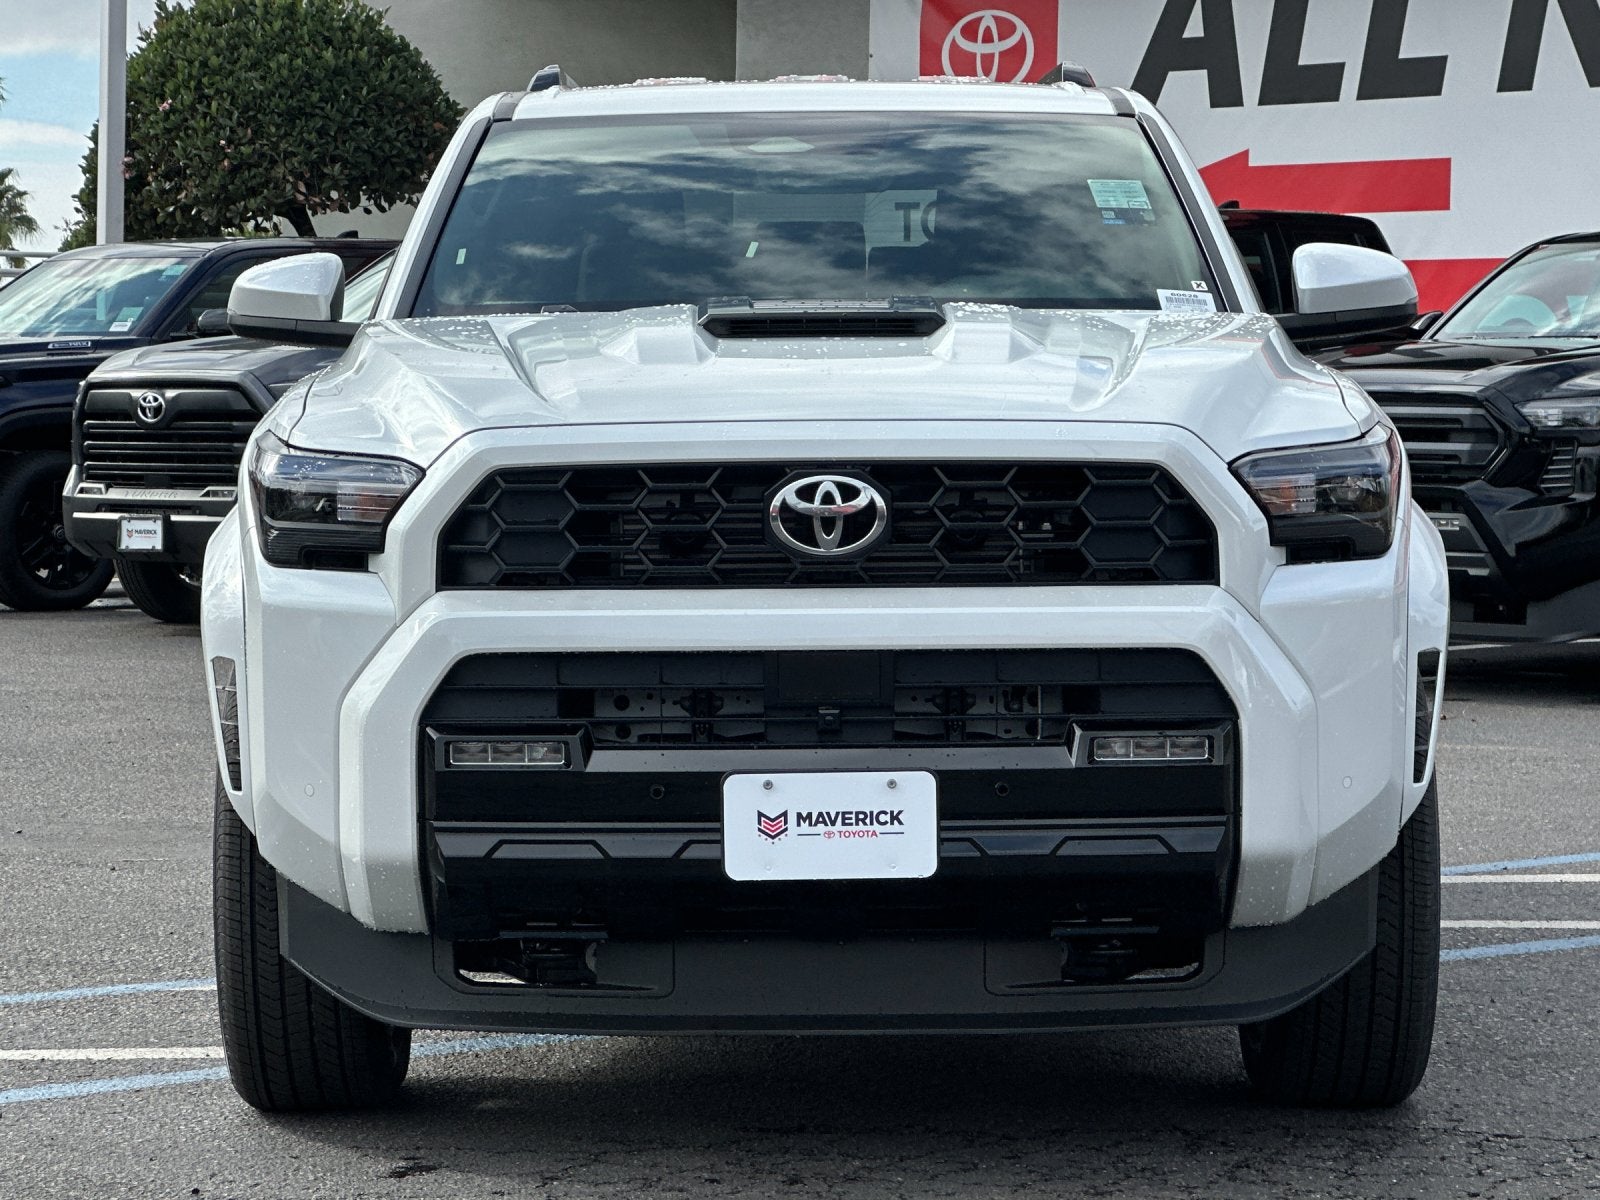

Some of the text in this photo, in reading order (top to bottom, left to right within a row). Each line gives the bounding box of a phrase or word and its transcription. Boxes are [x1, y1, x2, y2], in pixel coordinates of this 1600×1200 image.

[1131, 0, 1449, 108] ALL
[796, 810, 904, 827] MAVERICK
[837, 829, 878, 839] TOYOTA
